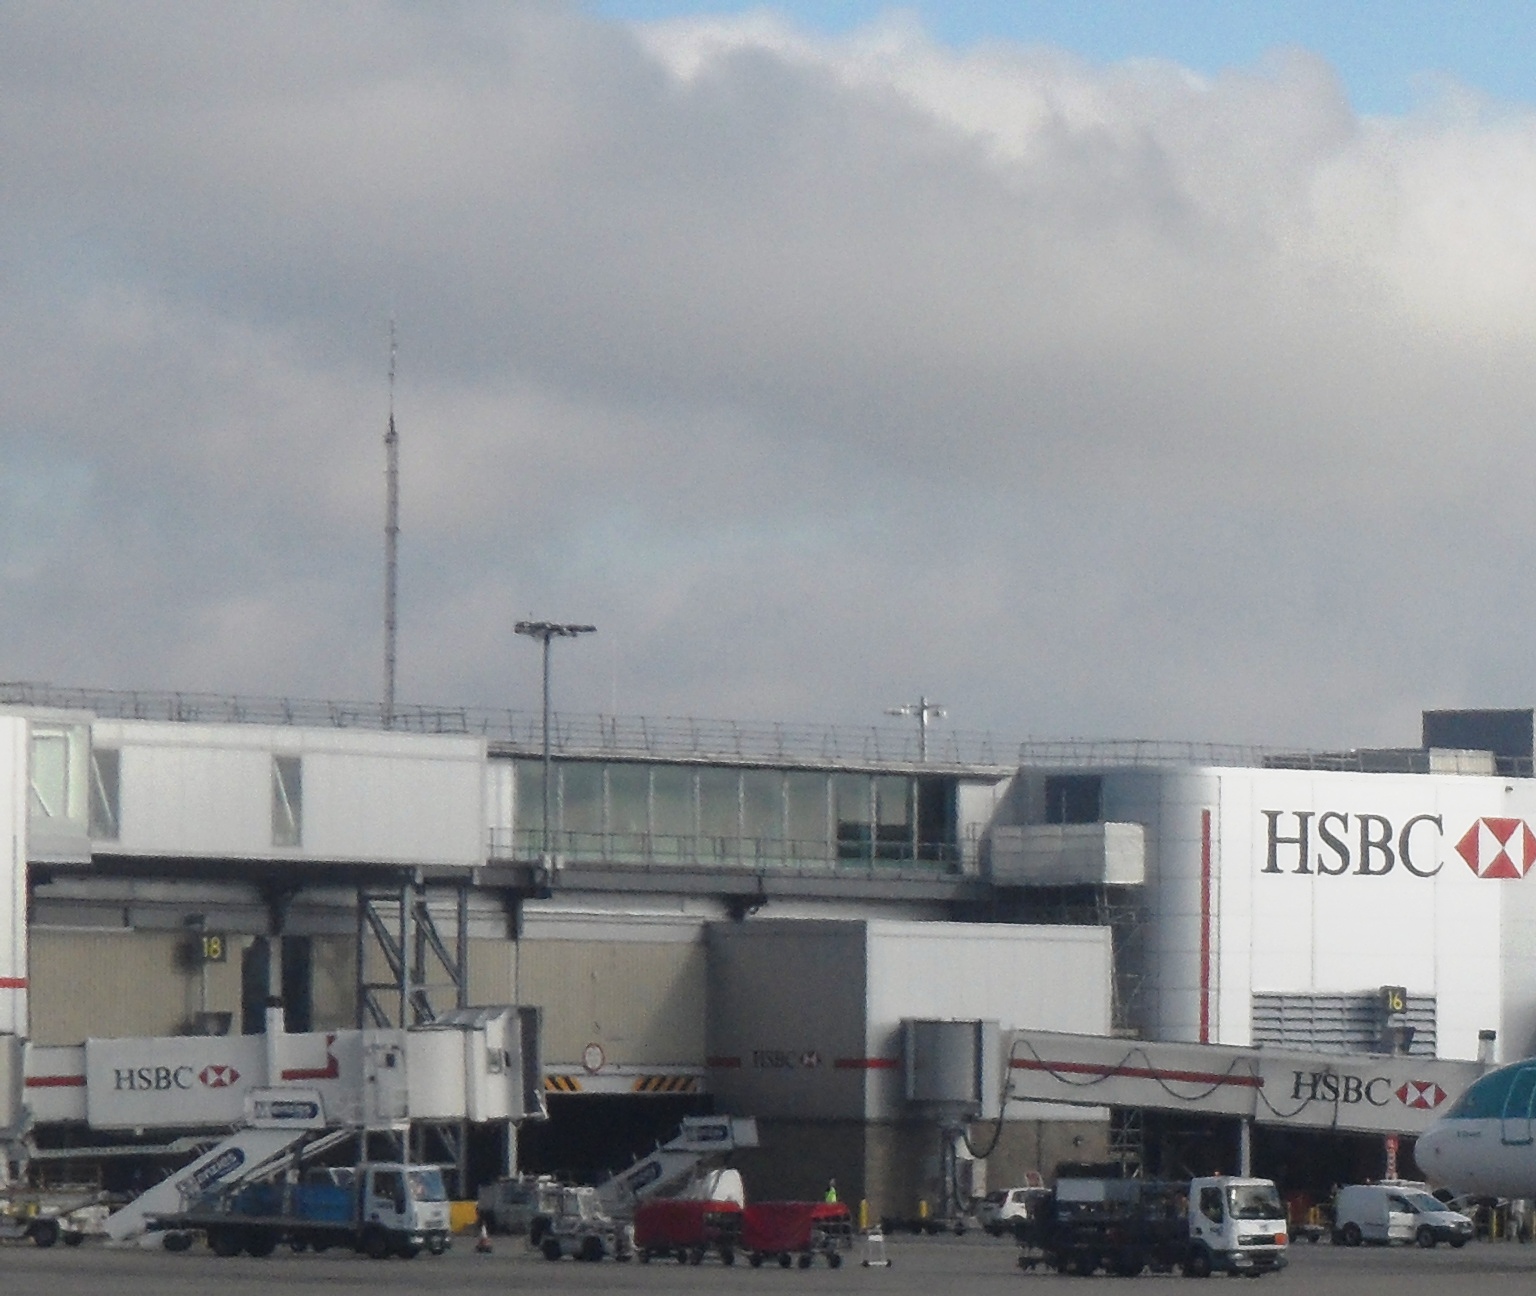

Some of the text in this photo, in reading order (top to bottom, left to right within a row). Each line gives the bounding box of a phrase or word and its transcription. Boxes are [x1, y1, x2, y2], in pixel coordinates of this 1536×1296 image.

[1260, 809, 1444, 878] HSBC
[203, 936, 221, 959] 18
[1388, 990, 1403, 1011] 16
[113, 1065, 194, 1090] HSBC
[1290, 1070, 1392, 1107] HSBC
